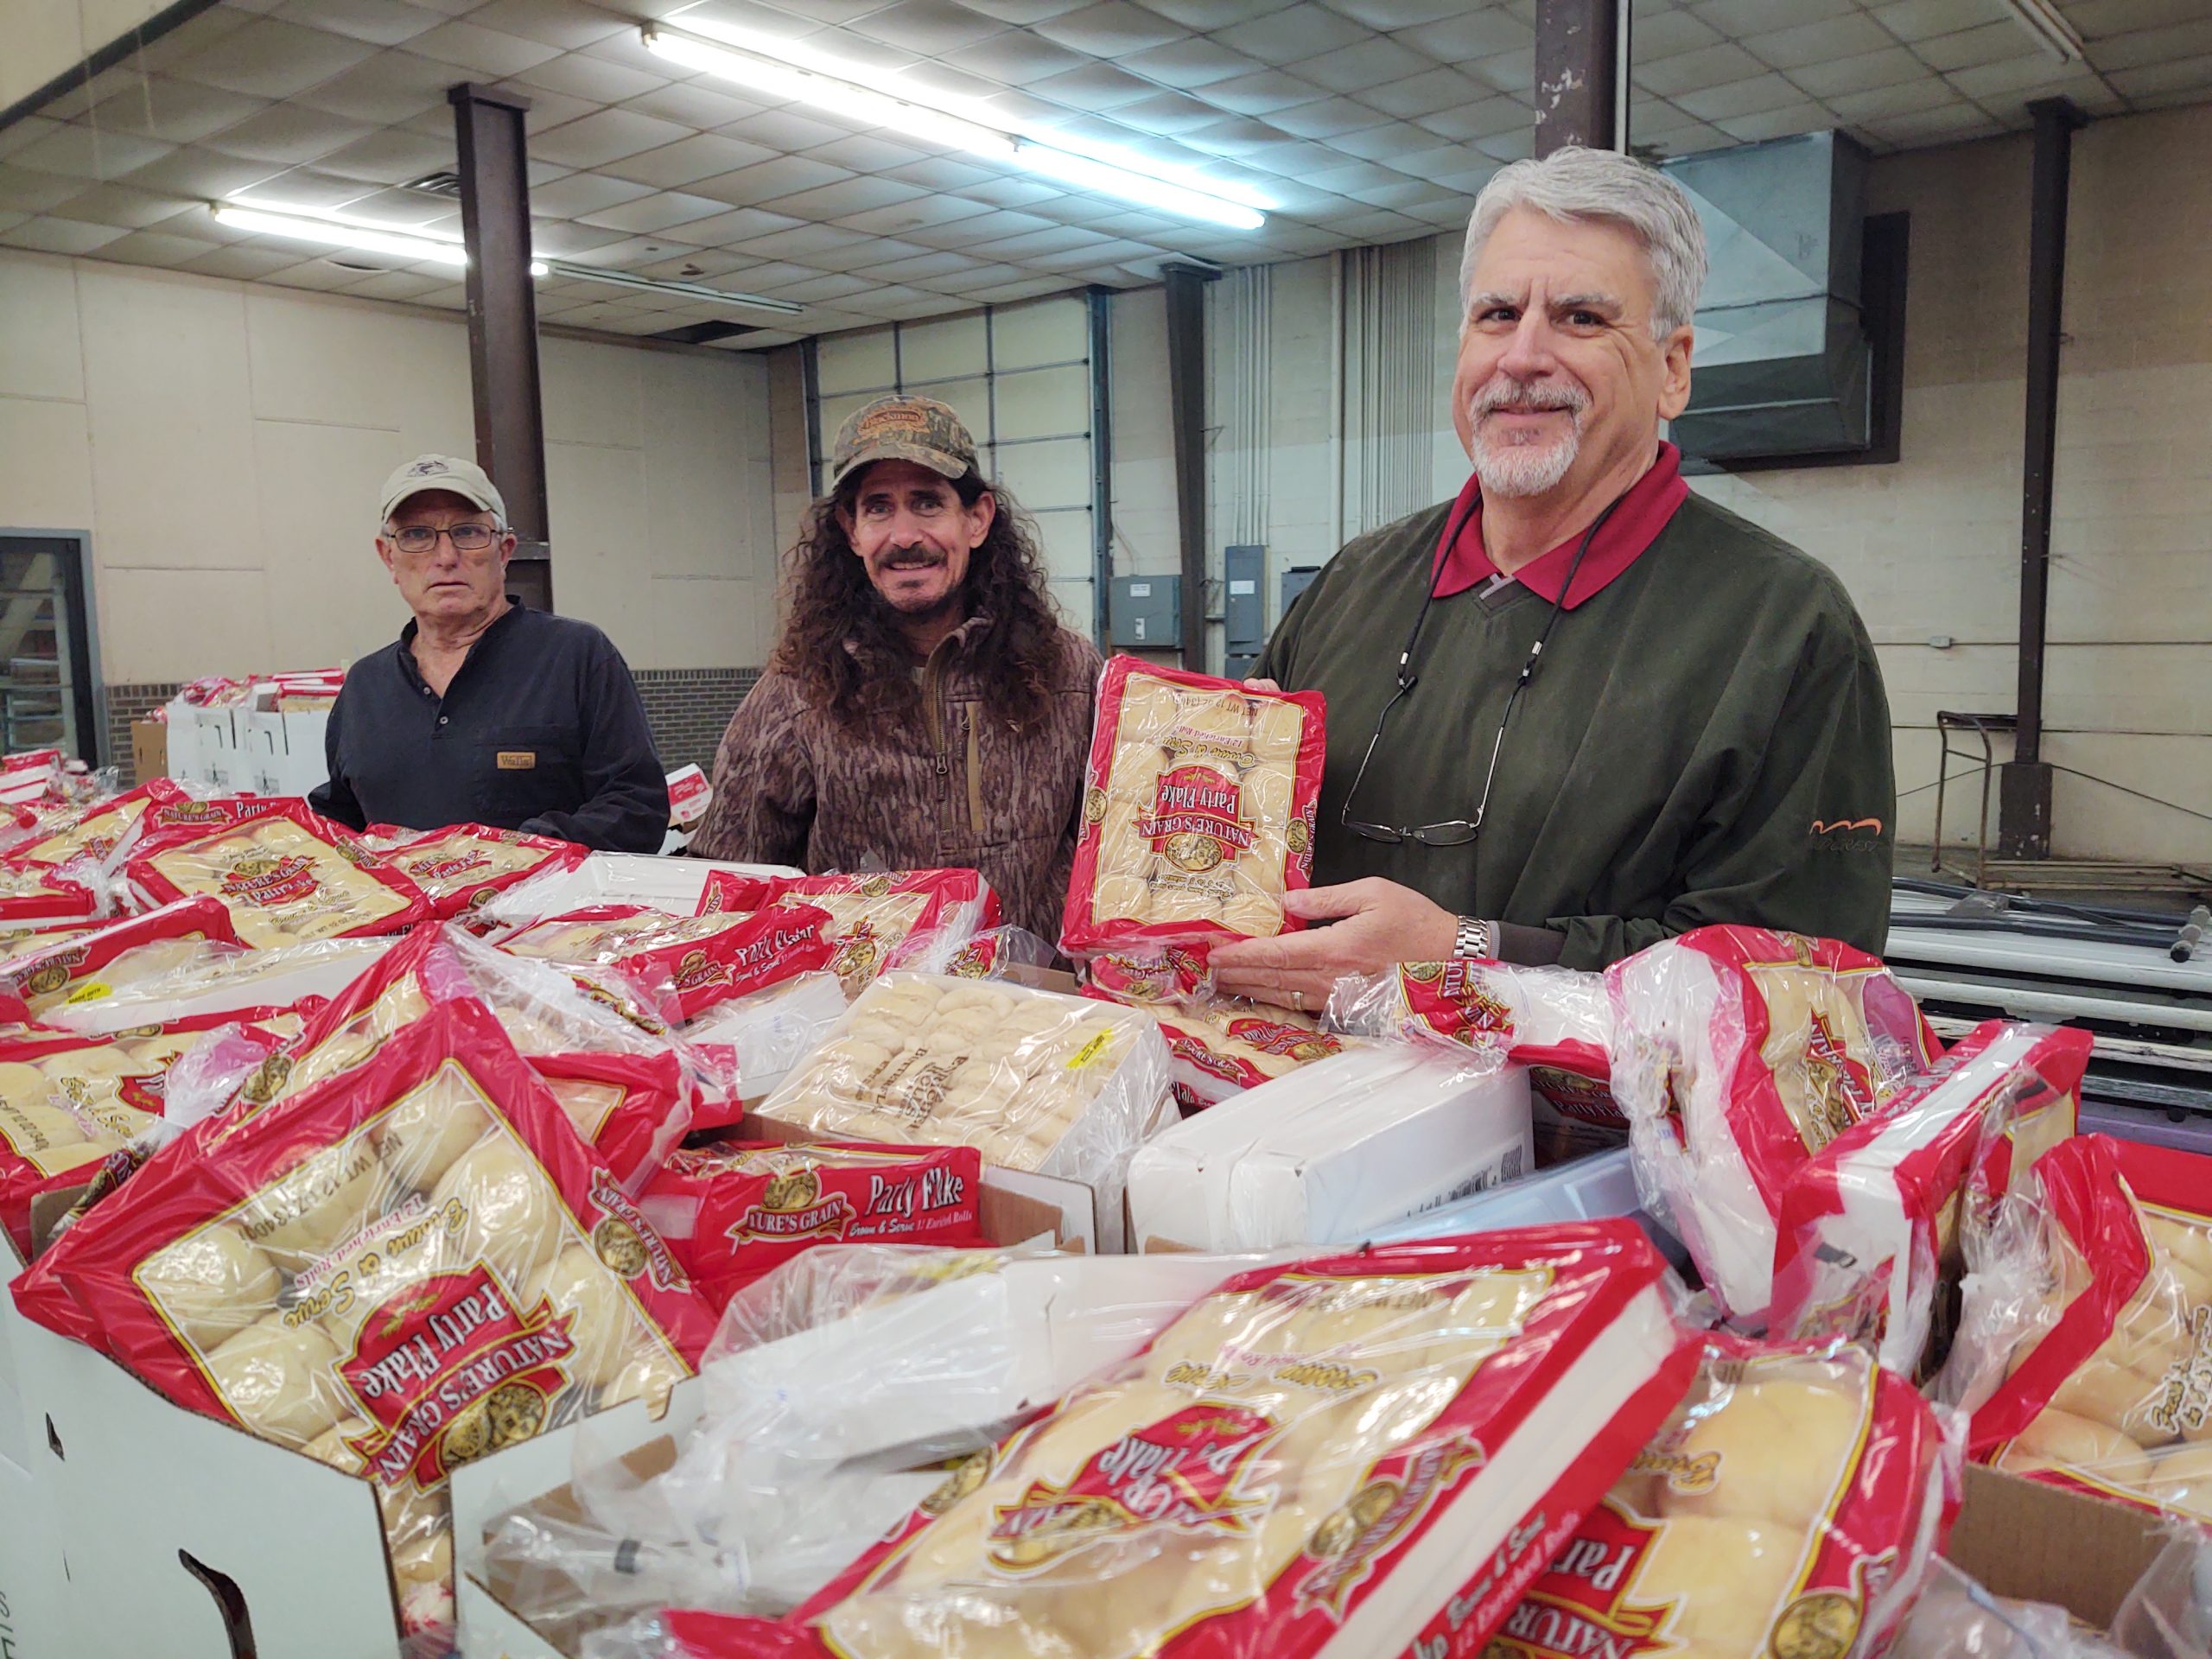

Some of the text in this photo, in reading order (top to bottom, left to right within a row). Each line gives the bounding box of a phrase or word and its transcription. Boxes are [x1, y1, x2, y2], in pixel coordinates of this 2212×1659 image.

[163, 809, 223, 822] NATURE'S GRAIN
[1161, 785, 1236, 814] Party Flake
[1142, 817, 1249, 846] NATURE'S GRAIN
[1599, 1103, 1624, 1120] Fla
[346, 1155, 372, 1184] WT
[799, 1200, 843, 1230] GRAIN
[865, 1174, 916, 1220] Party
[953, 1211, 973, 1224] Rolls
[296, 1197, 423, 1288] 12 Enriched Rolls
[283, 1197, 468, 1329] Brown & Serve
[358, 1282, 509, 1399] Party Flake
[378, 1325, 569, 1482] NATURE'S GRAIN
[1550, 1538, 1636, 1592] Par
[1509, 1602, 1636, 1659] NATUR
